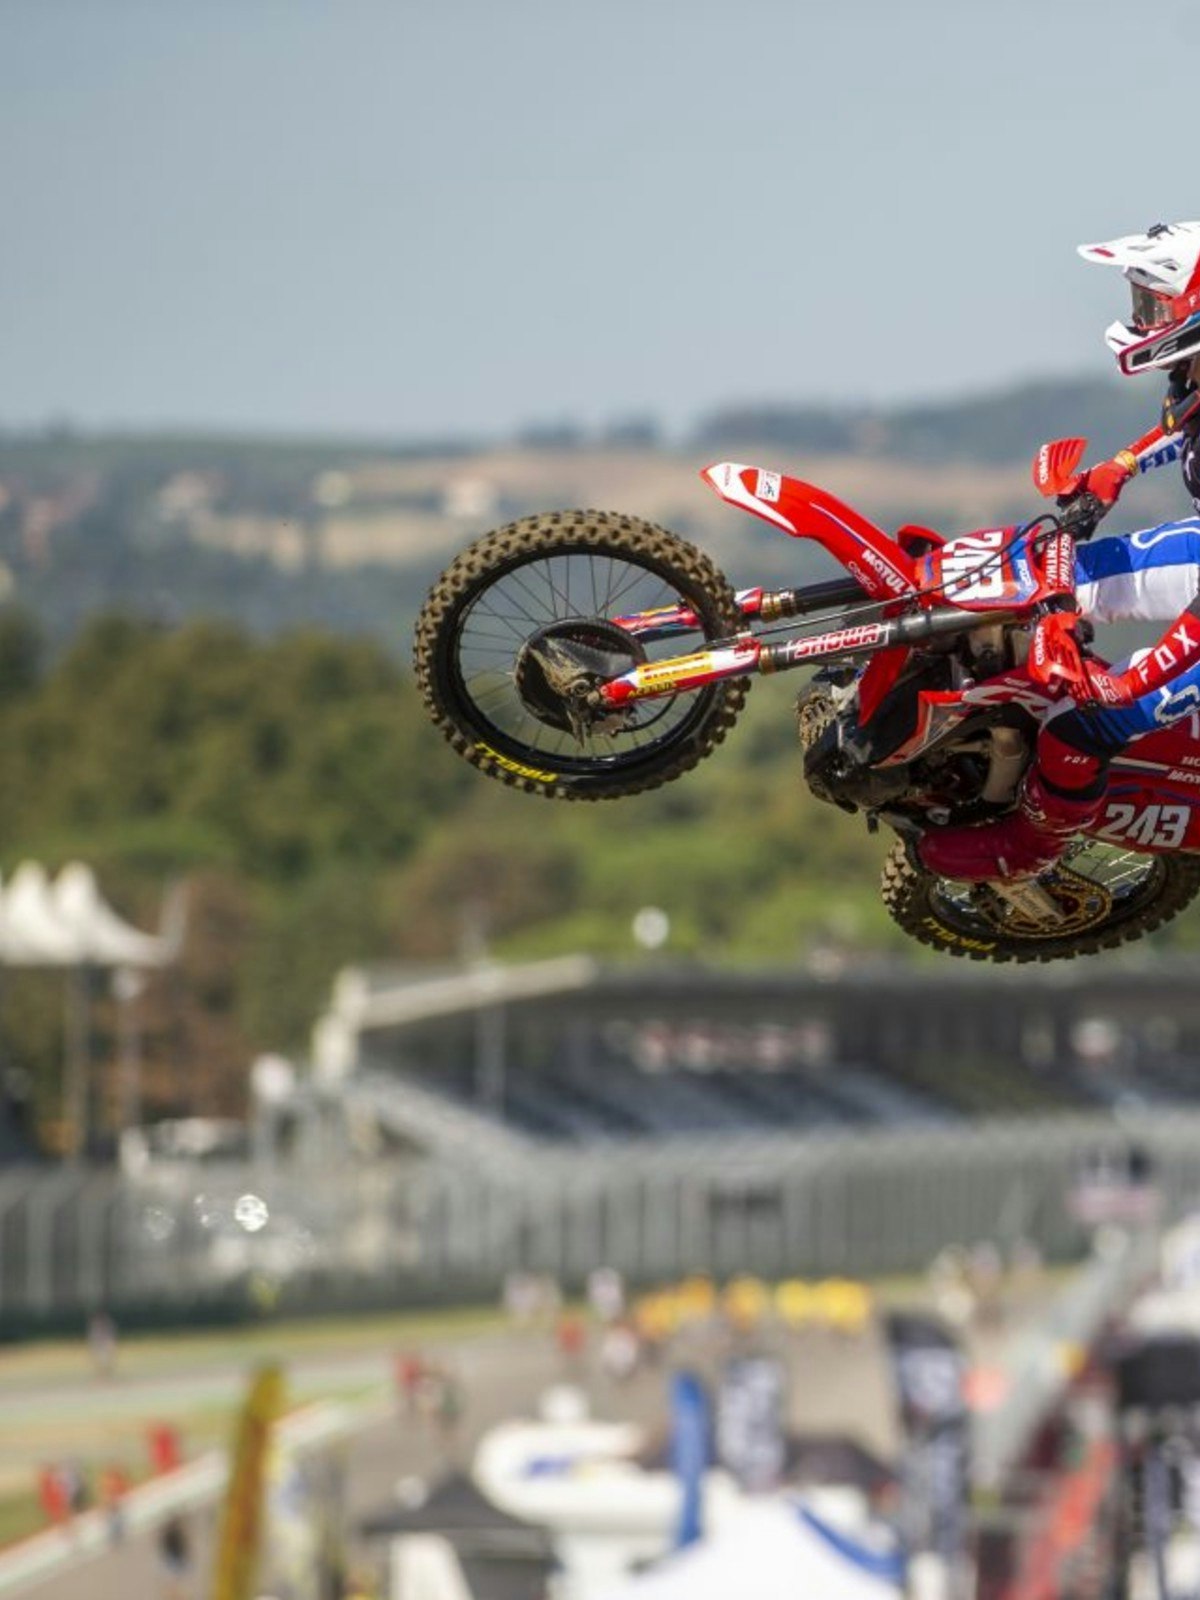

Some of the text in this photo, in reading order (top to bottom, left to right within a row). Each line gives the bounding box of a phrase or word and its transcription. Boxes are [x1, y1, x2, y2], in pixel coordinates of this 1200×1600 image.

[861, 549, 906, 595] MOTUL
[794, 622, 880, 660] SHOWA
[1137, 623, 1199, 685] FOX
[474, 742, 558, 783] PIRELLI
[1063, 754, 1091, 764] FOX
[1104, 803, 1192, 849] 243
